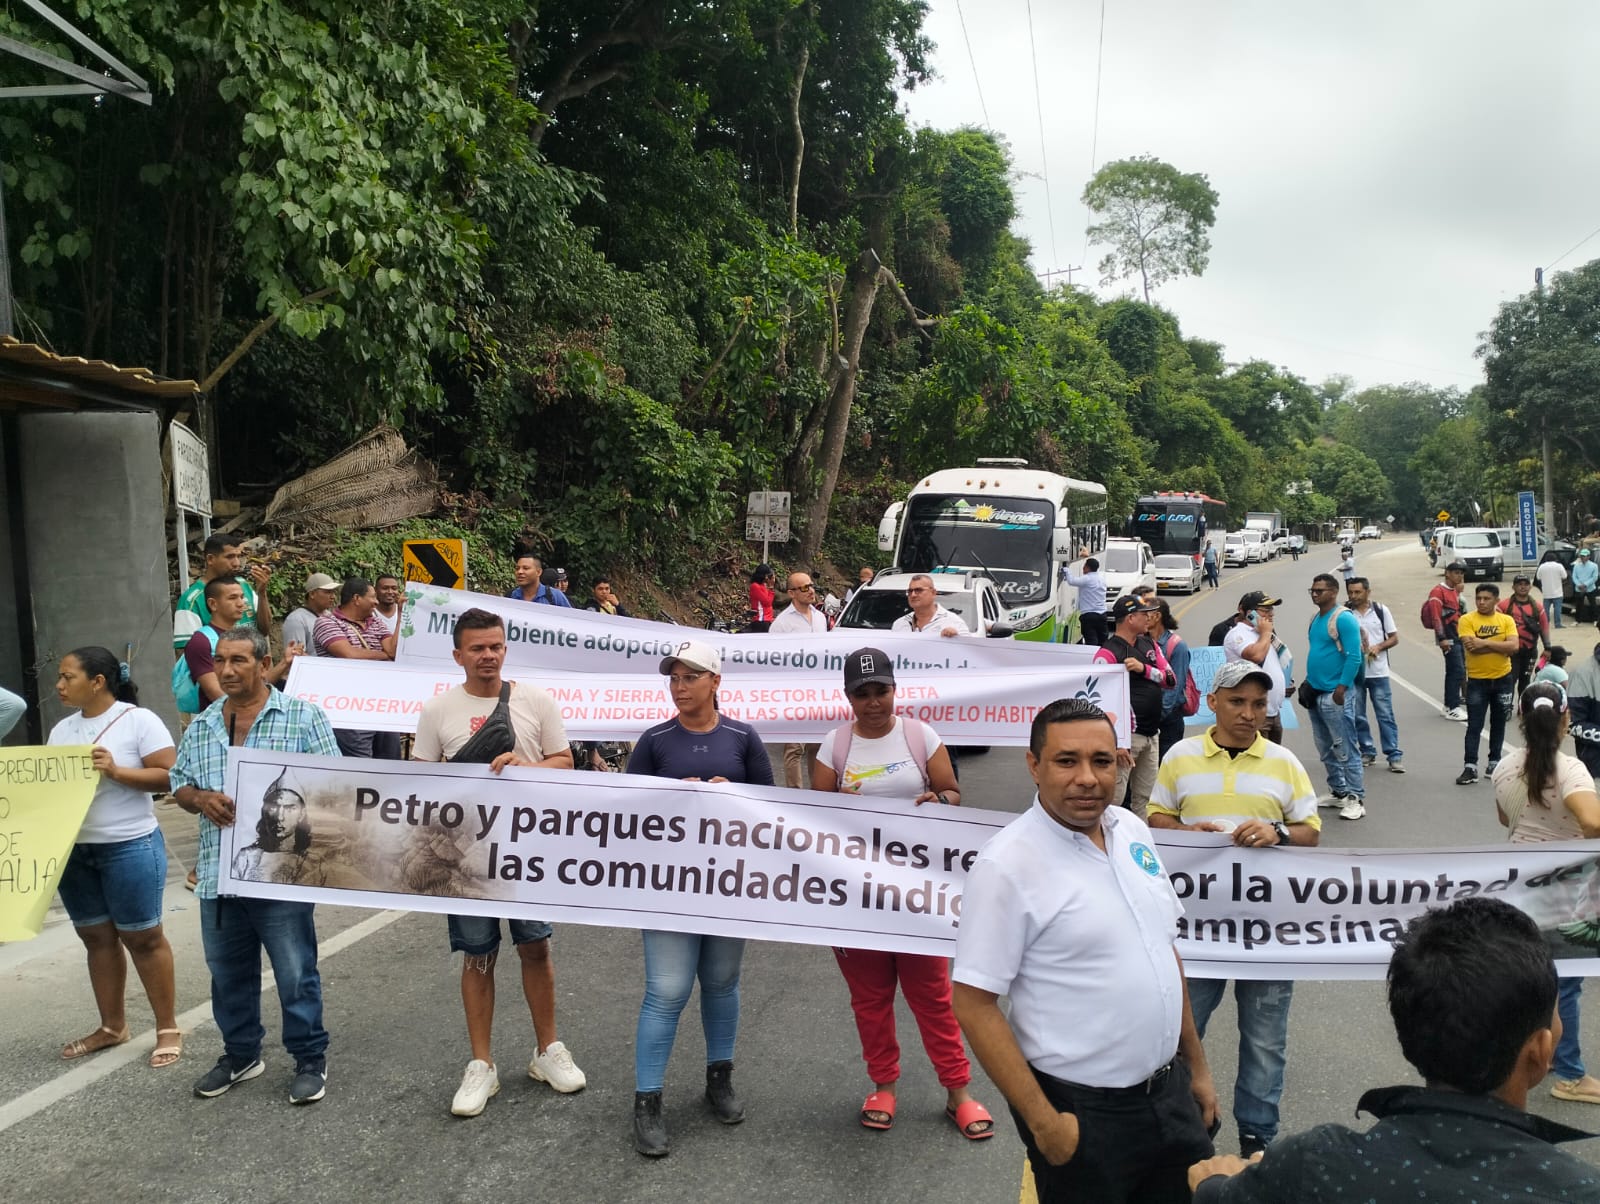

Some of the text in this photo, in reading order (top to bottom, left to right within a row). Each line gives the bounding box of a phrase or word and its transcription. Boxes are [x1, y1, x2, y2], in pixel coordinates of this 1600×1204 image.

[1000, 581, 1043, 597] Rey
[1478, 625, 1500, 634] NIKE
[583, 633, 678, 659] adopció
[731, 648, 818, 669] acuerdo
[676, 641, 691, 657] P
[588, 689, 600, 702] Y
[604, 689, 666, 703] SIERRA
[750, 689, 816, 702] SECTOR
[821, 688, 842, 701] LA
[746, 707, 778, 720] LAS
[918, 705, 955, 723] QUE
[959, 705, 980, 721] LO
[354, 788, 464, 829] Petro
[476, 804, 501, 840] y
[511, 806, 686, 848] parques
[698, 816, 931, 870] nacionales
[1169, 872, 1217, 900] or
[1232, 863, 1272, 902] la
[1288, 867, 1518, 905] voluntad
[488, 843, 545, 883] las
[557, 857, 848, 907] comunidades
